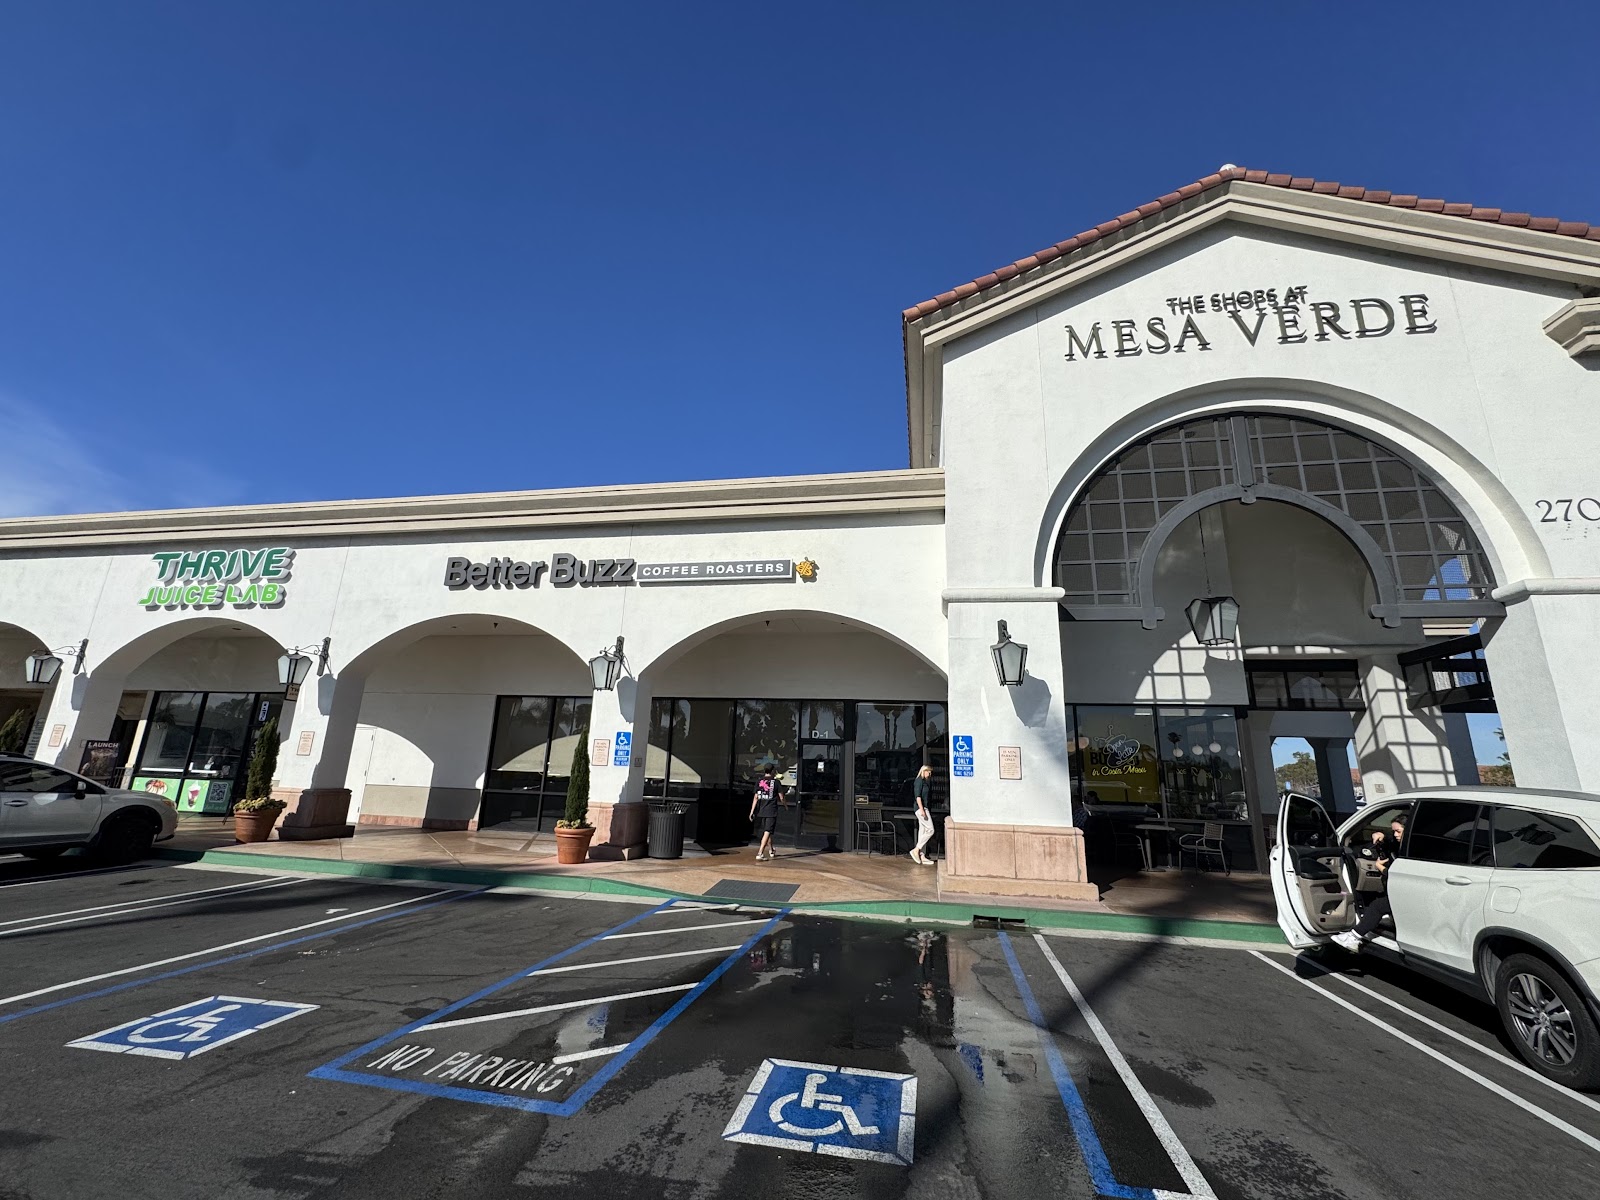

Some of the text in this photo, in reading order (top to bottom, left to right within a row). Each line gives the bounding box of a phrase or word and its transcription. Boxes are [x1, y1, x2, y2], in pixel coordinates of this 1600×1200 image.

[1166, 285, 1309, 315] THE SHOPS AT
[1064, 293, 1438, 361] MESA VERDE
[152, 547, 294, 583] THRIVE
[444, 552, 636, 589] Better Buzz
[642, 562, 785, 576] COFFEE ROASTERS
[138, 583, 283, 608] JUICE LAB
[811, 730, 829, 739] D-1
[87, 741, 119, 749] LAUNCH
[953, 750, 973, 758] PARKING
[1107, 739, 1124, 755] Open
[956, 757, 970, 765] ONLY
[366, 1044, 574, 1093] NO PARKING
